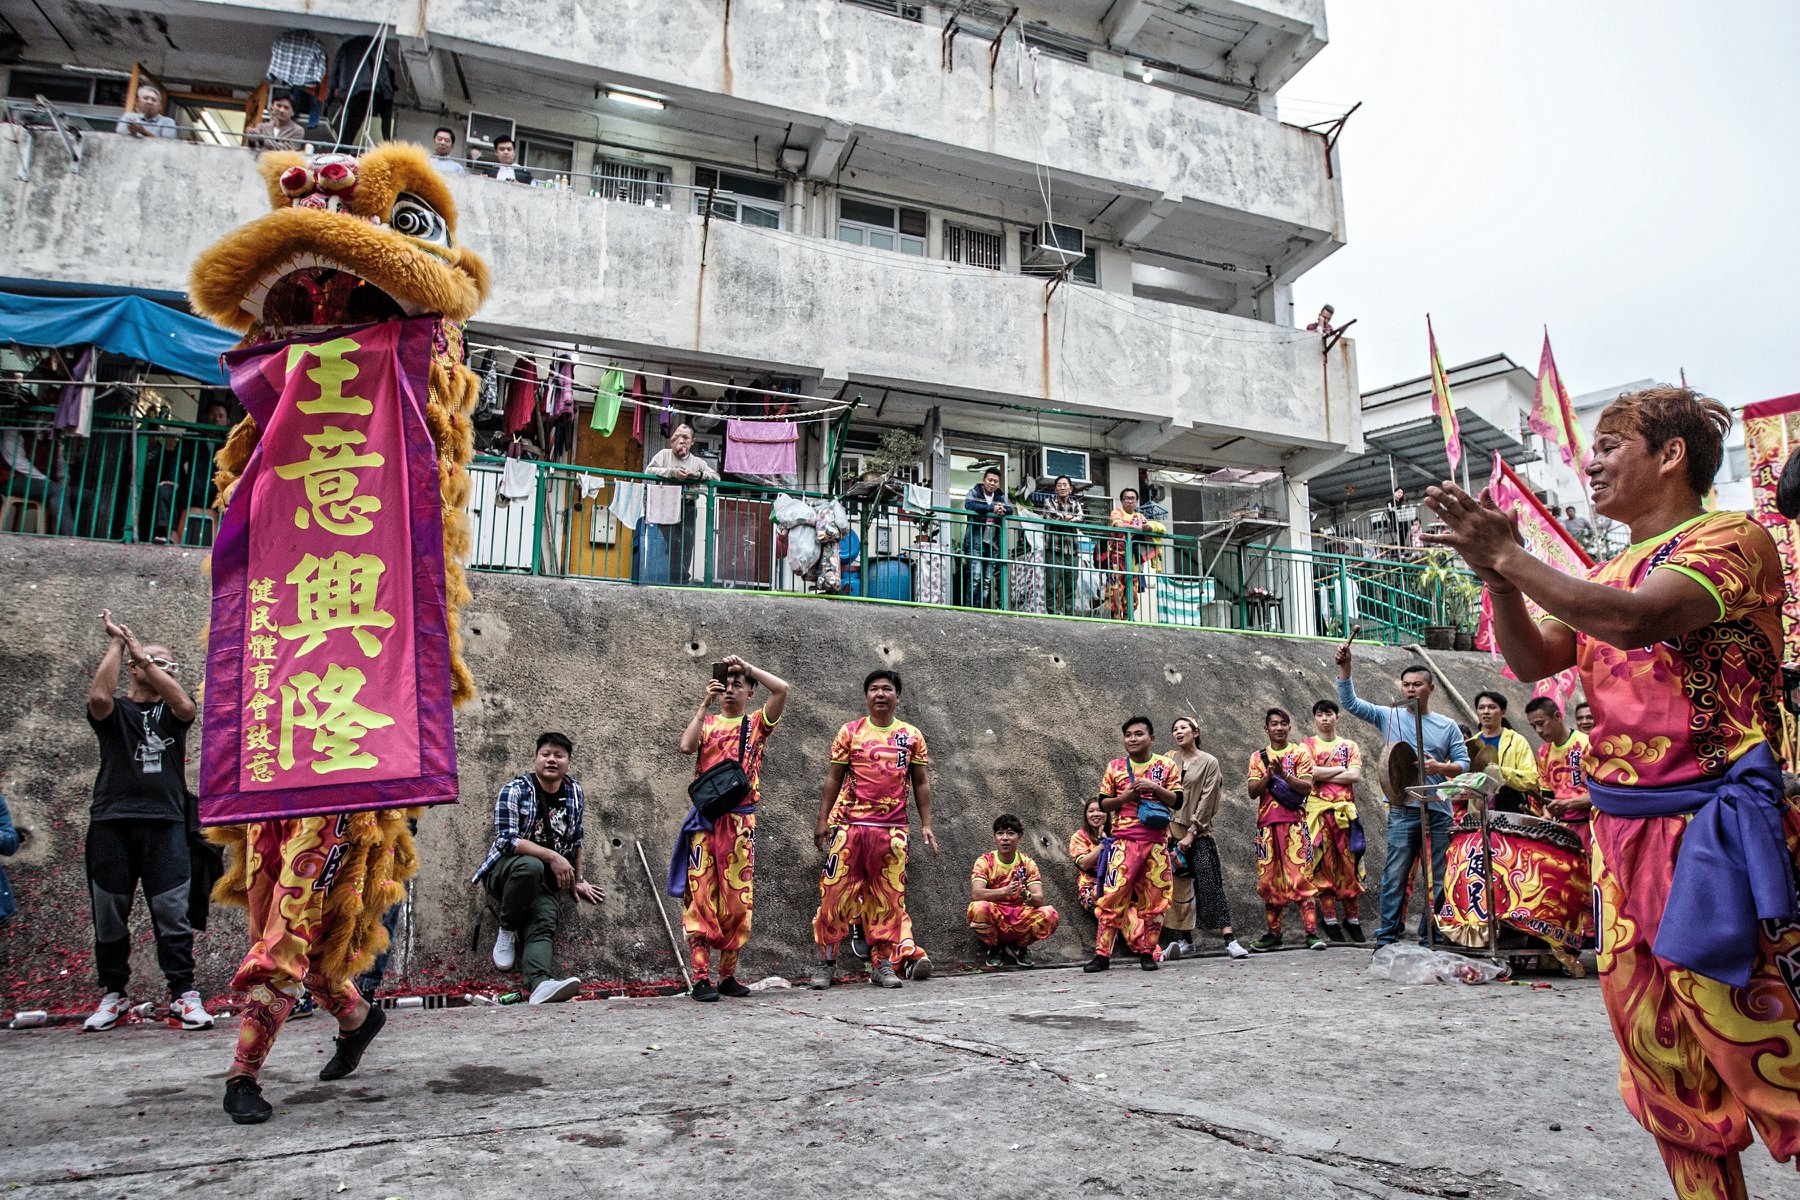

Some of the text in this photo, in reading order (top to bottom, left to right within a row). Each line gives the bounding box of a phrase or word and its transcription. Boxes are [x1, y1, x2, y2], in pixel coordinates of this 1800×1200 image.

[245, 576, 280, 783] 健民體育會致意
[894, 733, 910, 768] 健民
[1569, 750, 1583, 787] 健民
[1526, 919, 1553, 936] KUNG
